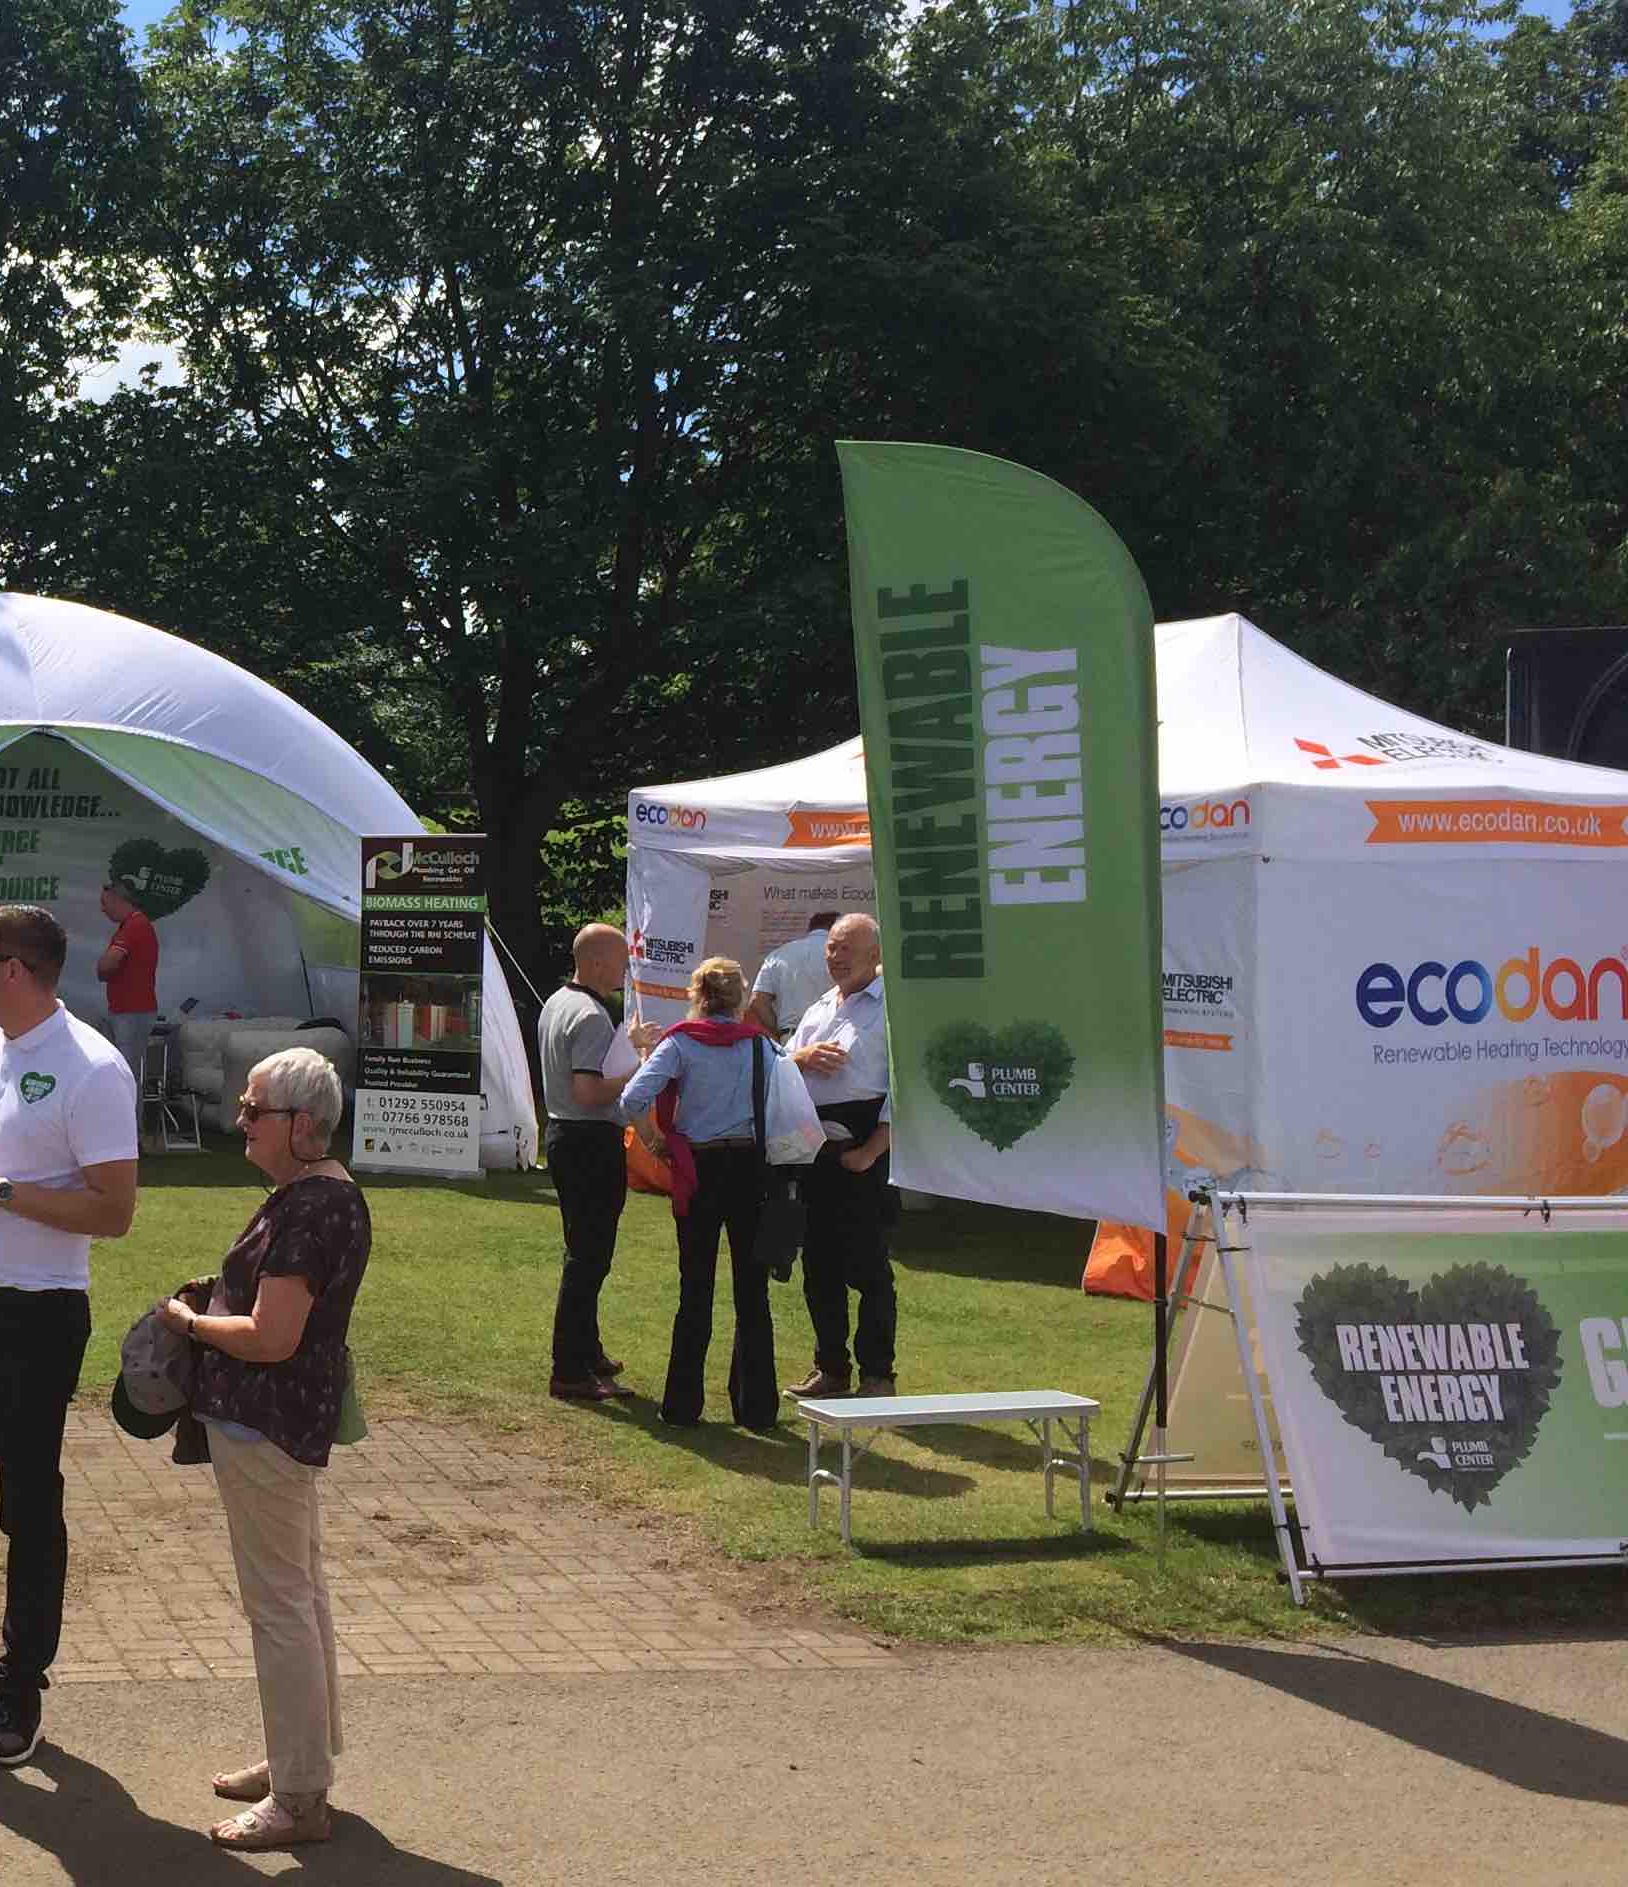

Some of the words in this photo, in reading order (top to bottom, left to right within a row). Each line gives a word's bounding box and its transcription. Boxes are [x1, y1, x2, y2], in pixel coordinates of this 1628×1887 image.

[28, 767, 61, 790] ALL
[877, 576, 985, 980] RENEWABLE
[978, 643, 1087, 907] ENERGY
[635, 802, 708, 831] ecodan
[1397, 806, 1602, 837] www.ecodan.co.uk
[763, 885, 797, 901] What
[799, 885, 838, 901] makes
[365, 896, 422, 910] BIOMASS
[424, 897, 479, 911] HEATING
[369, 919, 406, 928] PAYBACK
[407, 920, 430, 929] OVER
[438, 919, 464, 929] YEARS
[369, 929, 409, 939] THROUGH
[411, 930, 426, 939] THE
[444, 931, 477, 941] SCHEME
[368, 945, 407, 955] REDUCED
[408, 946, 443, 955] CARBON
[645, 936, 694, 953] MITSUBISHI
[368, 955, 413, 965] EMISSIONS
[646, 951, 686, 964] ELECTRIC
[1161, 973, 1233, 989] MITSUBISHI
[1355, 945, 1628, 1029] ecodan
[1162, 988, 1226, 1004] ELECTRIC
[1373, 1040, 1472, 1065] Renewable
[1476, 1039, 1540, 1063] Heating
[1543, 1036, 1628, 1061] Technology
[991, 1067, 1037, 1080] PLUMB
[991, 1082, 1041, 1096] CENTER
[379, 1096, 417, 1110] 01292
[421, 1098, 466, 1112] 550954
[382, 1111, 420, 1123] 07766
[423, 1113, 469, 1127] 978568
[1335, 1322, 1530, 1371] RENEWABLE
[1379, 1374, 1506, 1423] ENERGY
[1451, 1439, 1490, 1453] PLUMB
[1455, 1454, 1495, 1466] CENTER
